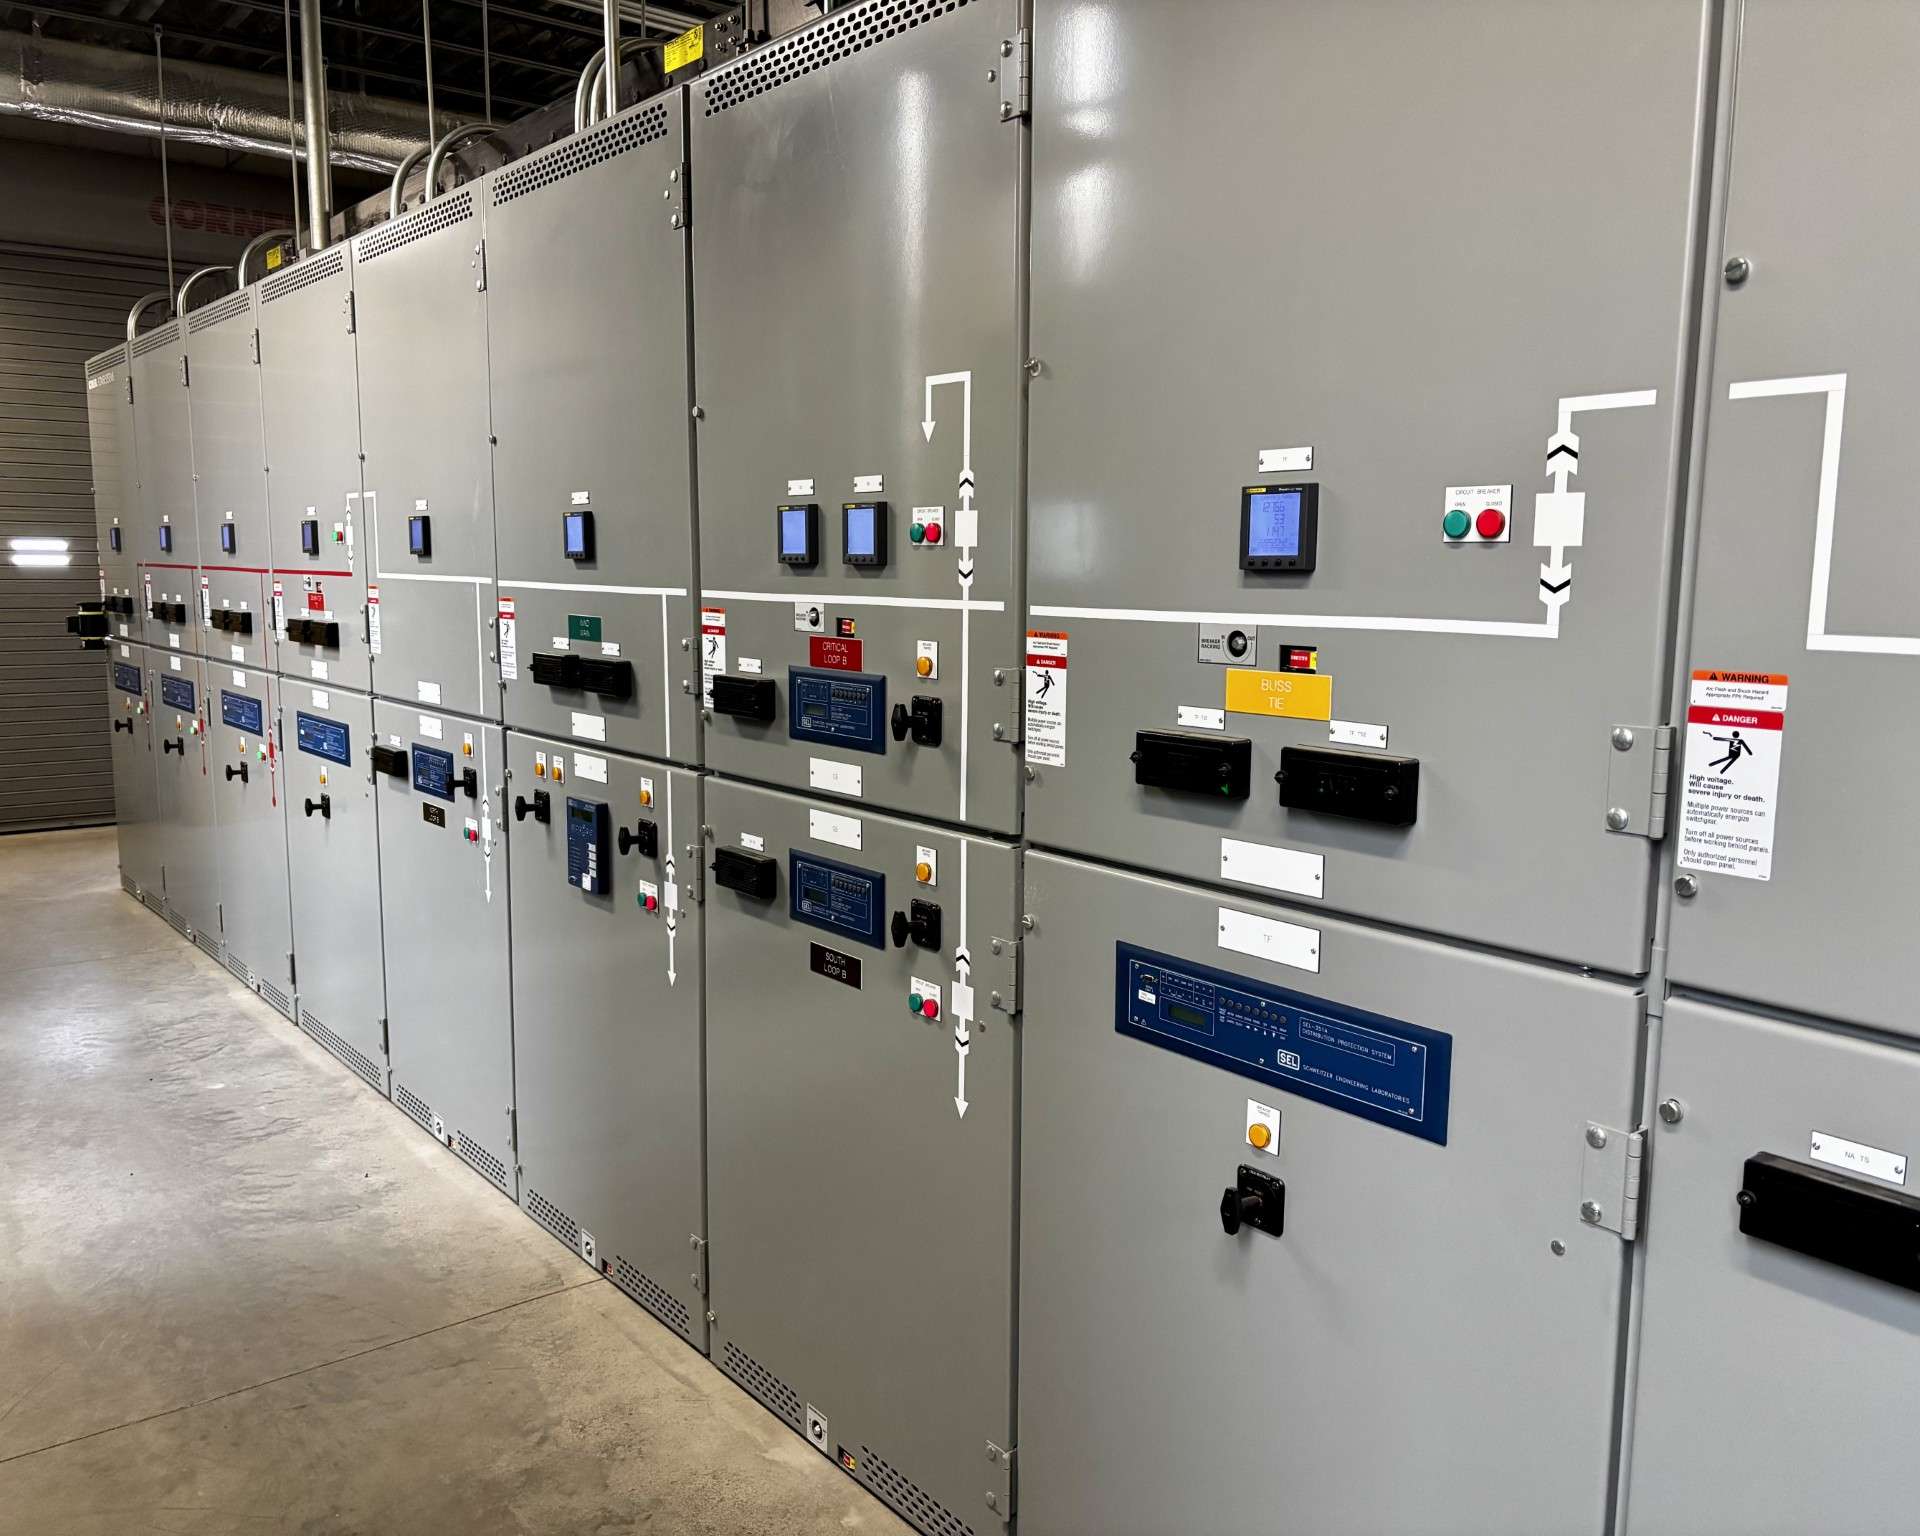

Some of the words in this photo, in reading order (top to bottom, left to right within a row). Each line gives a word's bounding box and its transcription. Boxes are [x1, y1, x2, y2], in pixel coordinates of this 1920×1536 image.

[822, 642, 848, 653] CRITICAL
[824, 655, 840, 664] LOOP
[842, 656, 847, 665] B
[1260, 678, 1292, 693] BUSS
[1722, 673, 1769, 684] WARNING
[1268, 697, 1284, 710] TIE
[1722, 715, 1758, 724] DANGER
[1689, 774, 1705, 782] High
[1707, 776, 1734, 785] voltage.
[1688, 788, 1710, 796] severe
[1712, 790, 1732, 800] injury
[1743, 794, 1766, 803] death.
[1686, 809, 1724, 820] automatically
[1725, 813, 1750, 822] energize
[1688, 801, 1710, 810] Multiple
[1730, 807, 1753, 816] sources
[1684, 835, 1702, 843] before
[1703, 838, 1726, 848] working
[1728, 842, 1748, 850] behind
[1749, 845, 1770, 854] panels.
[1735, 836, 1758, 844] sources
[1683, 856, 1702, 864] should
[1718, 862, 1735, 870] panel.
[1684, 849, 1696, 857] Only
[1697, 850, 1726, 860] authorized
[1728, 856, 1758, 866] personnel
[825, 952, 846, 966] SOUTH
[824, 963, 840, 976] LOOP
[842, 970, 846, 979] B
[1302, 1028, 1335, 1043] DISTRIBUTION
[1337, 1039, 1369, 1054] PROTECTION
[1372, 1050, 1392, 1060] SYSTEM
[1280, 1052, 1297, 1067] SEL
[1303, 1064, 1333, 1080] SCHWEITZER
[1336, 1075, 1369, 1091] ENGINEERING
[1371, 1087, 1410, 1104] LABORATORIES
[1860, 1155, 1870, 1164] TS
